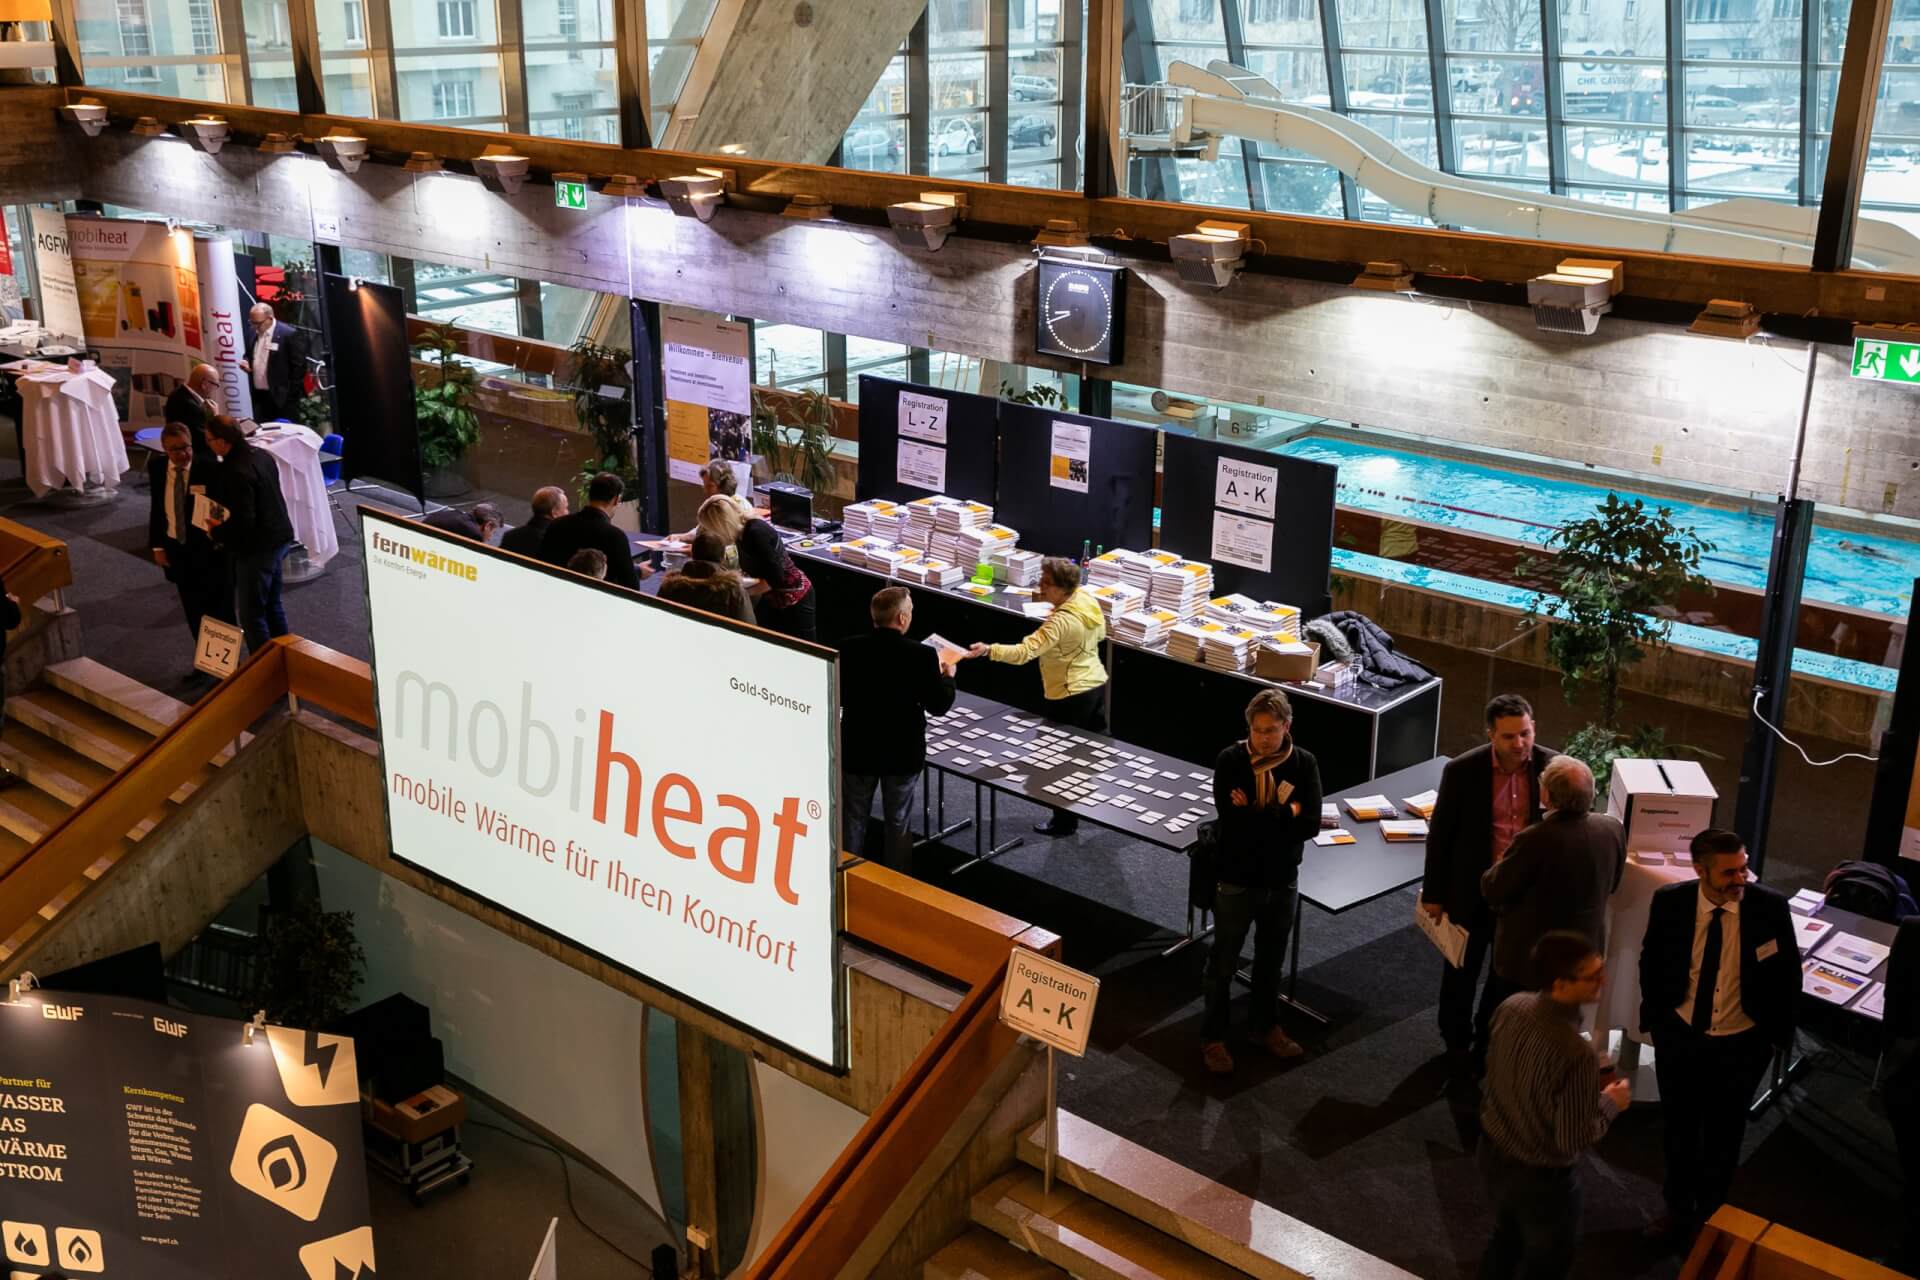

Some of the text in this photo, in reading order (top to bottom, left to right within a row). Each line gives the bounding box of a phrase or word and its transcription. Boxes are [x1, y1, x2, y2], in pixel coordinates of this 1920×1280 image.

[38, 232, 70, 257] AGFW
[668, 343, 705, 358] Willkommen
[902, 397, 944, 413] Registration
[908, 411, 917, 427] L
[928, 415, 938, 431] Z
[1222, 464, 1274, 484] Registration
[1225, 480, 1239, 498] A
[1254, 486, 1267, 504] K
[372, 531, 478, 582] fernwärme
[205, 641, 212, 658] L
[221, 647, 231, 665] Z
[729, 676, 813, 715] Gold-Sponsor
[393, 773, 798, 972] mobile Wärme für Ihren Komfort
[1016, 962, 1088, 1001] Registration
[42, 1004, 84, 1021] GWF
[1016, 987, 1034, 1014] A
[1056, 1002, 1078, 1031] K
[153, 1017, 188, 1038] GWF
[36, 1078, 52, 1089] für
[0, 1093, 66, 1113] ASSER
[123, 1085, 185, 1104] Kernkompetenz
